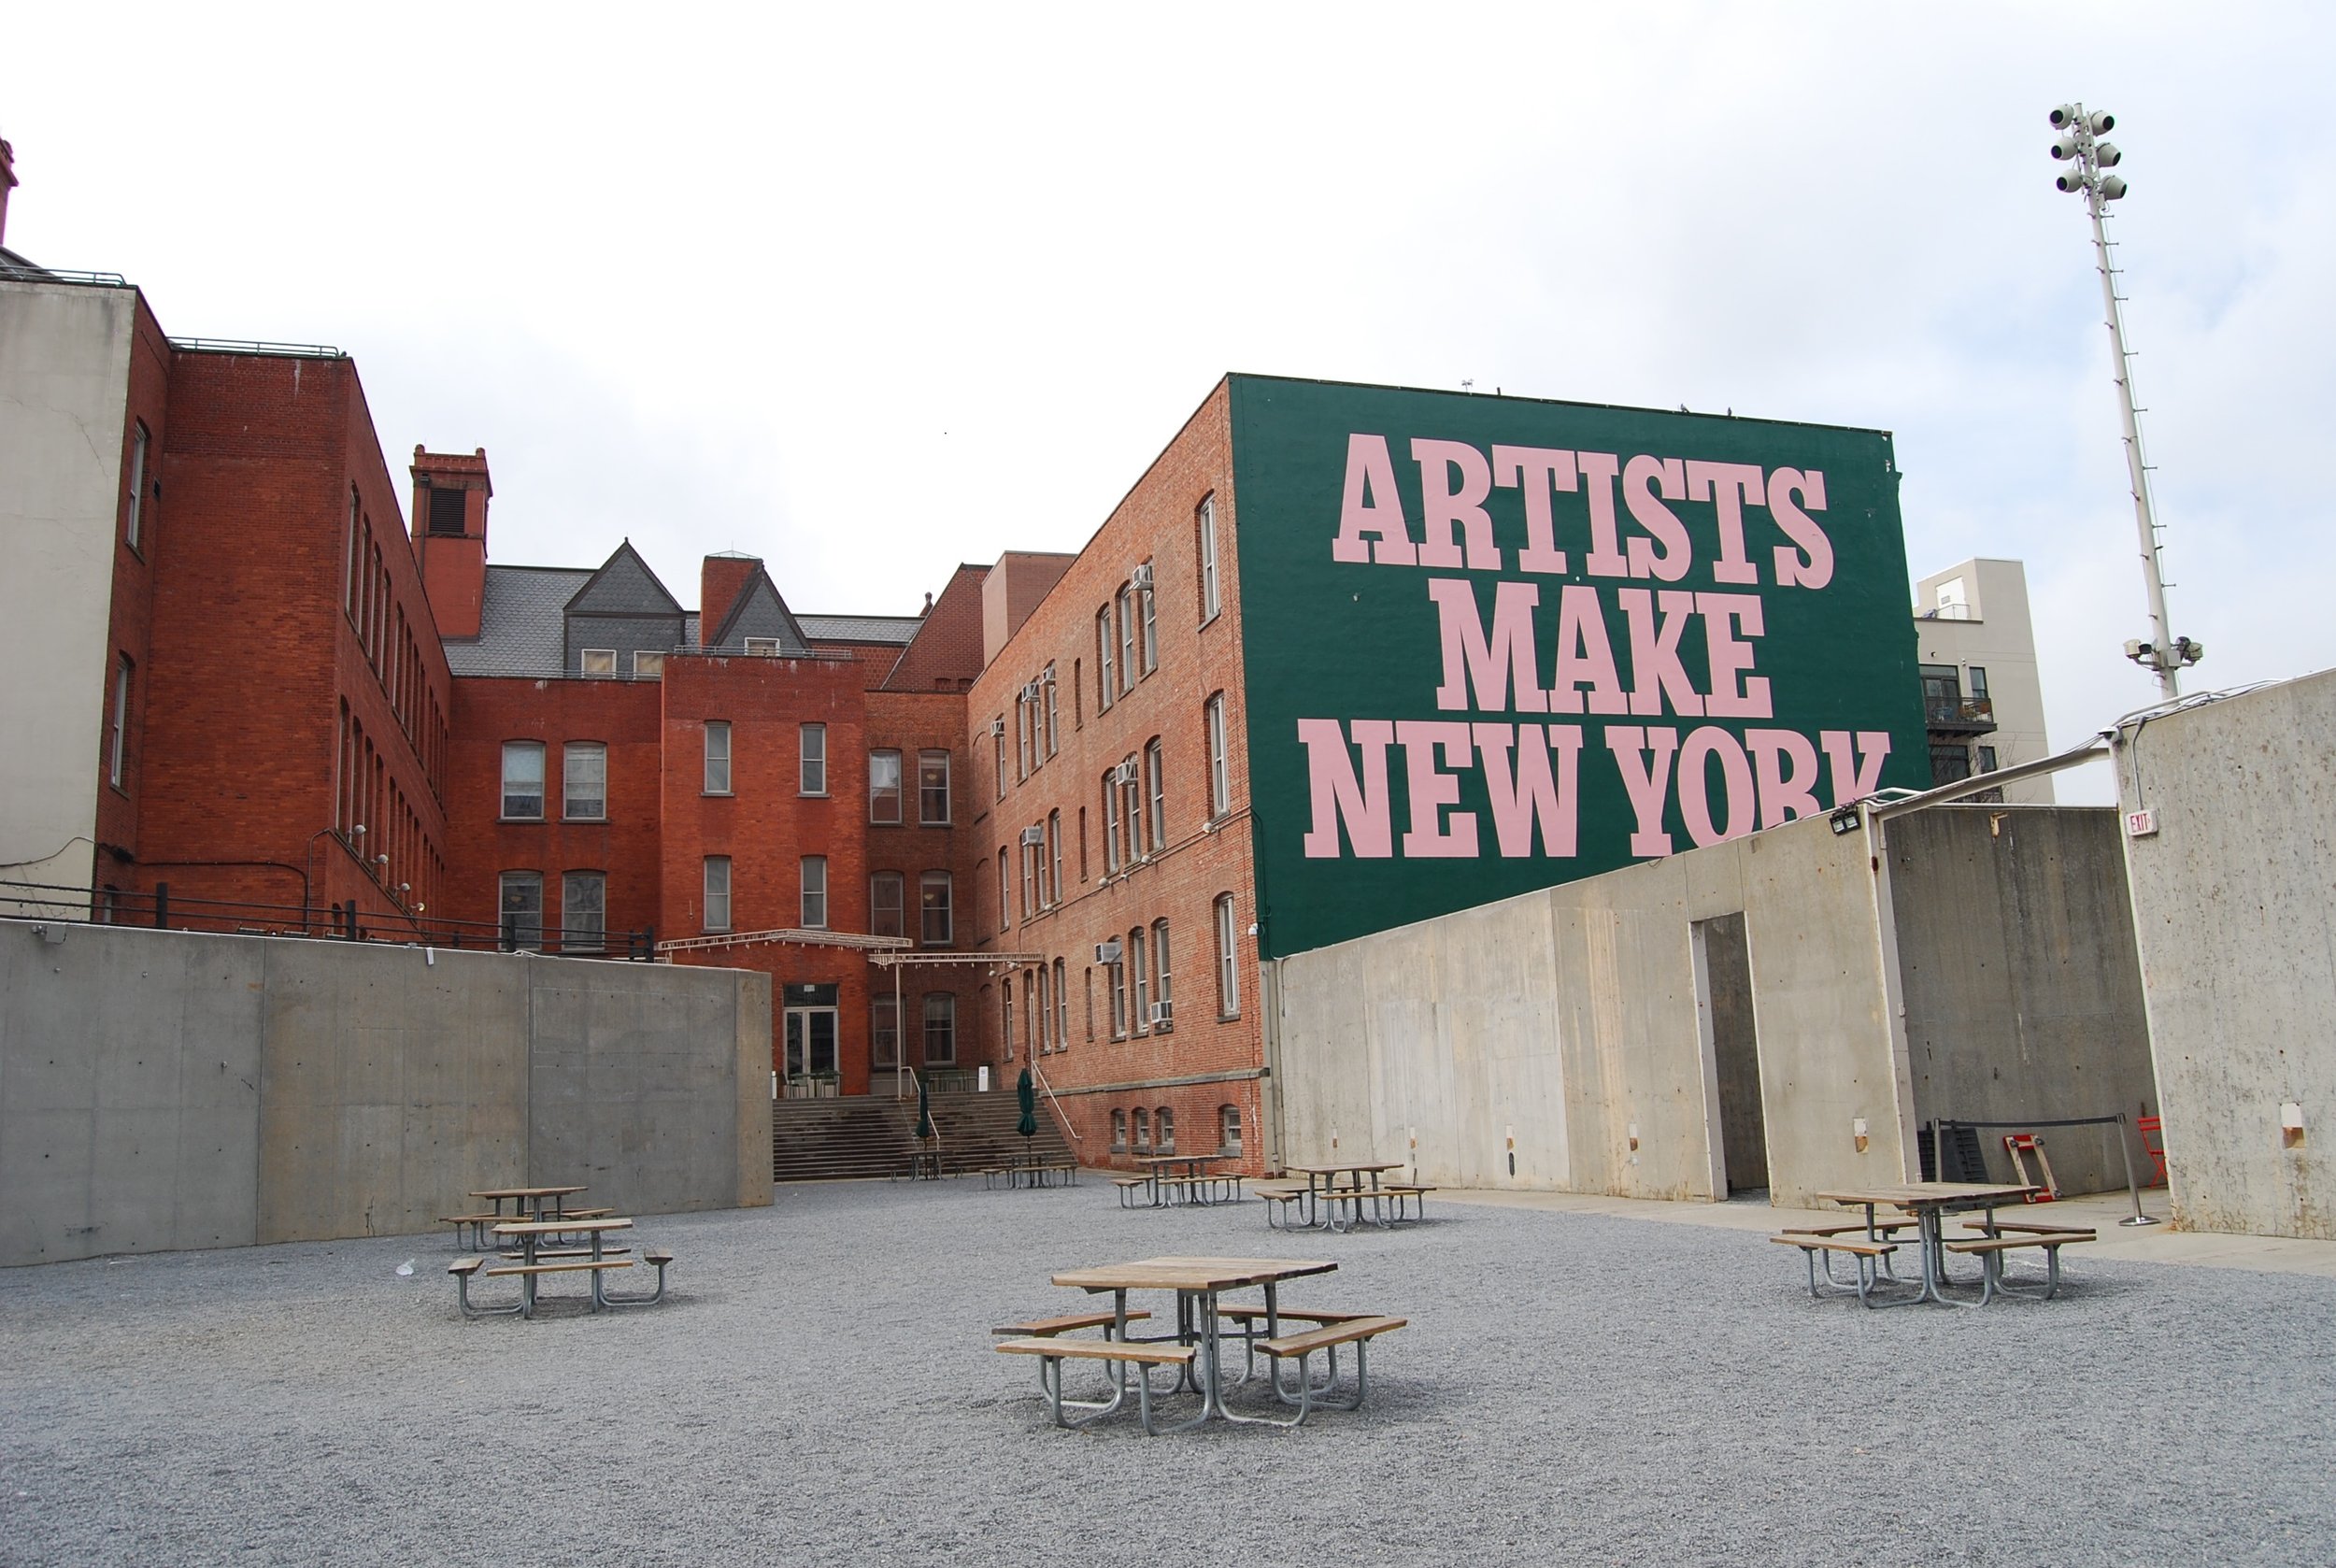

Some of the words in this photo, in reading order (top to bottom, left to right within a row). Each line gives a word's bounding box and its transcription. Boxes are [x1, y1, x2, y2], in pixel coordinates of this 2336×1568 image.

[1332, 433, 1835, 590] ARTISTS
[1429, 577, 1774, 719] MAKE
[1297, 718, 1584, 859] NEW
[2129, 813, 2148, 834] EXIT
